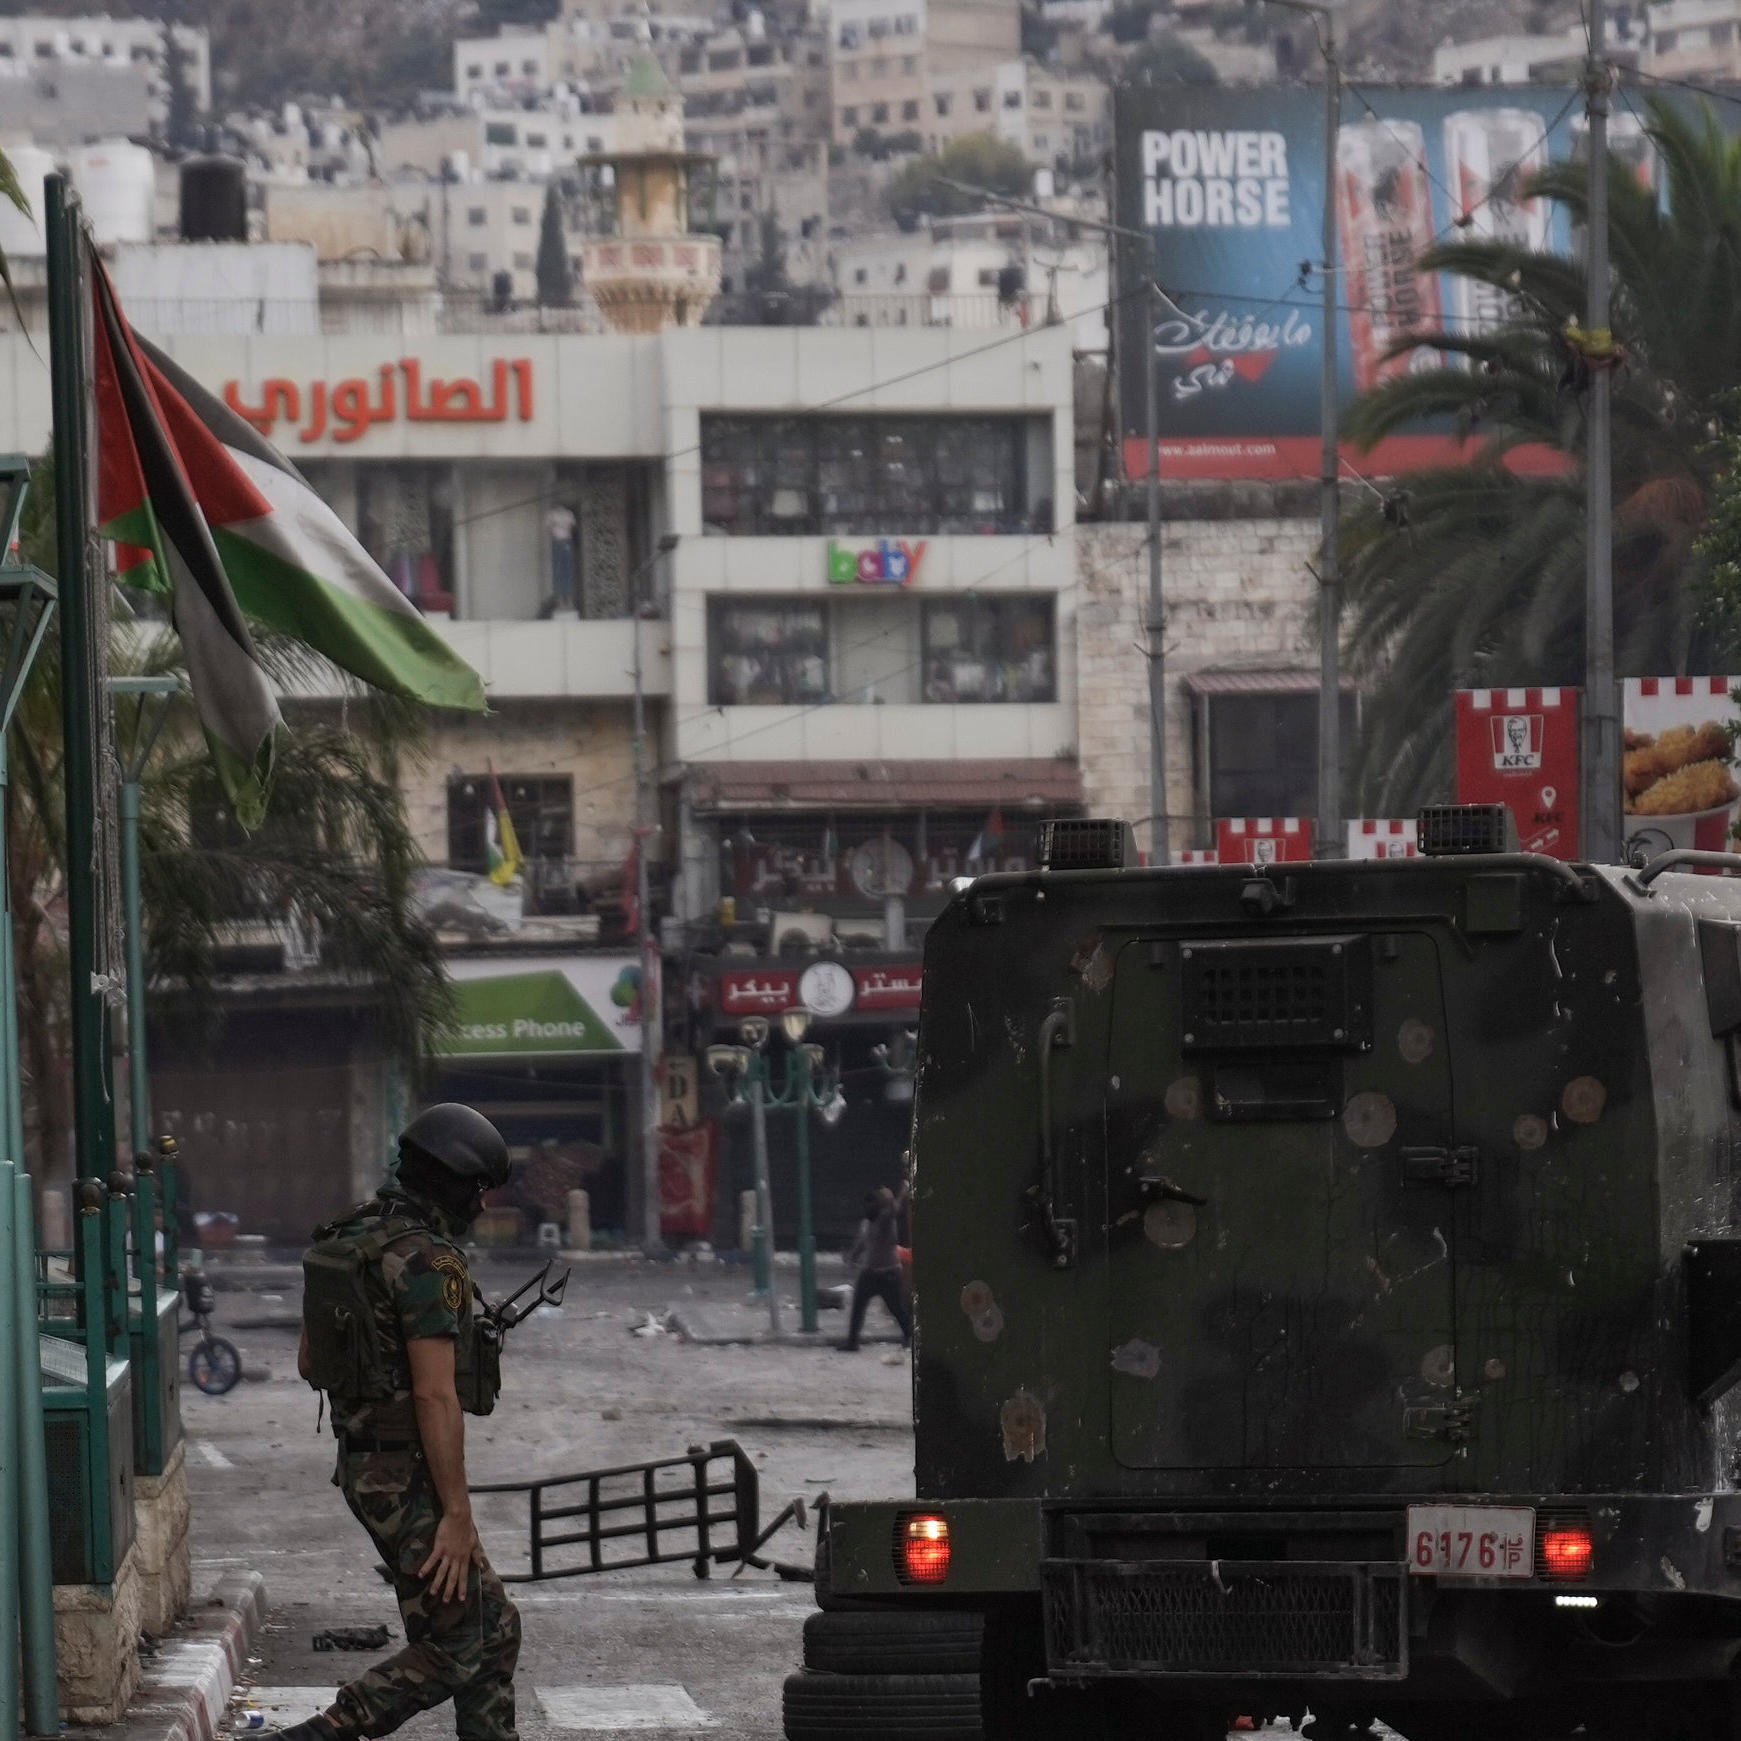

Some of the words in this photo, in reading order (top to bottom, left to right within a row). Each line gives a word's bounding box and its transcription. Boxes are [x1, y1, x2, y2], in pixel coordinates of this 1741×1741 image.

[1143, 128, 1288, 178] POWER
[1144, 177, 1291, 226] HORSE
[224, 357, 533, 443] الصانوري
[828, 538, 928, 584] baby
[1501, 754, 1534, 767] KFC
[1534, 811, 1564, 824] KFC
[729, 978, 790, 1003] بيكر
[513, 1018, 585, 1038] Phone
[1417, 1531, 1496, 1568] 6176
[1508, 1552, 1521, 1569] P
